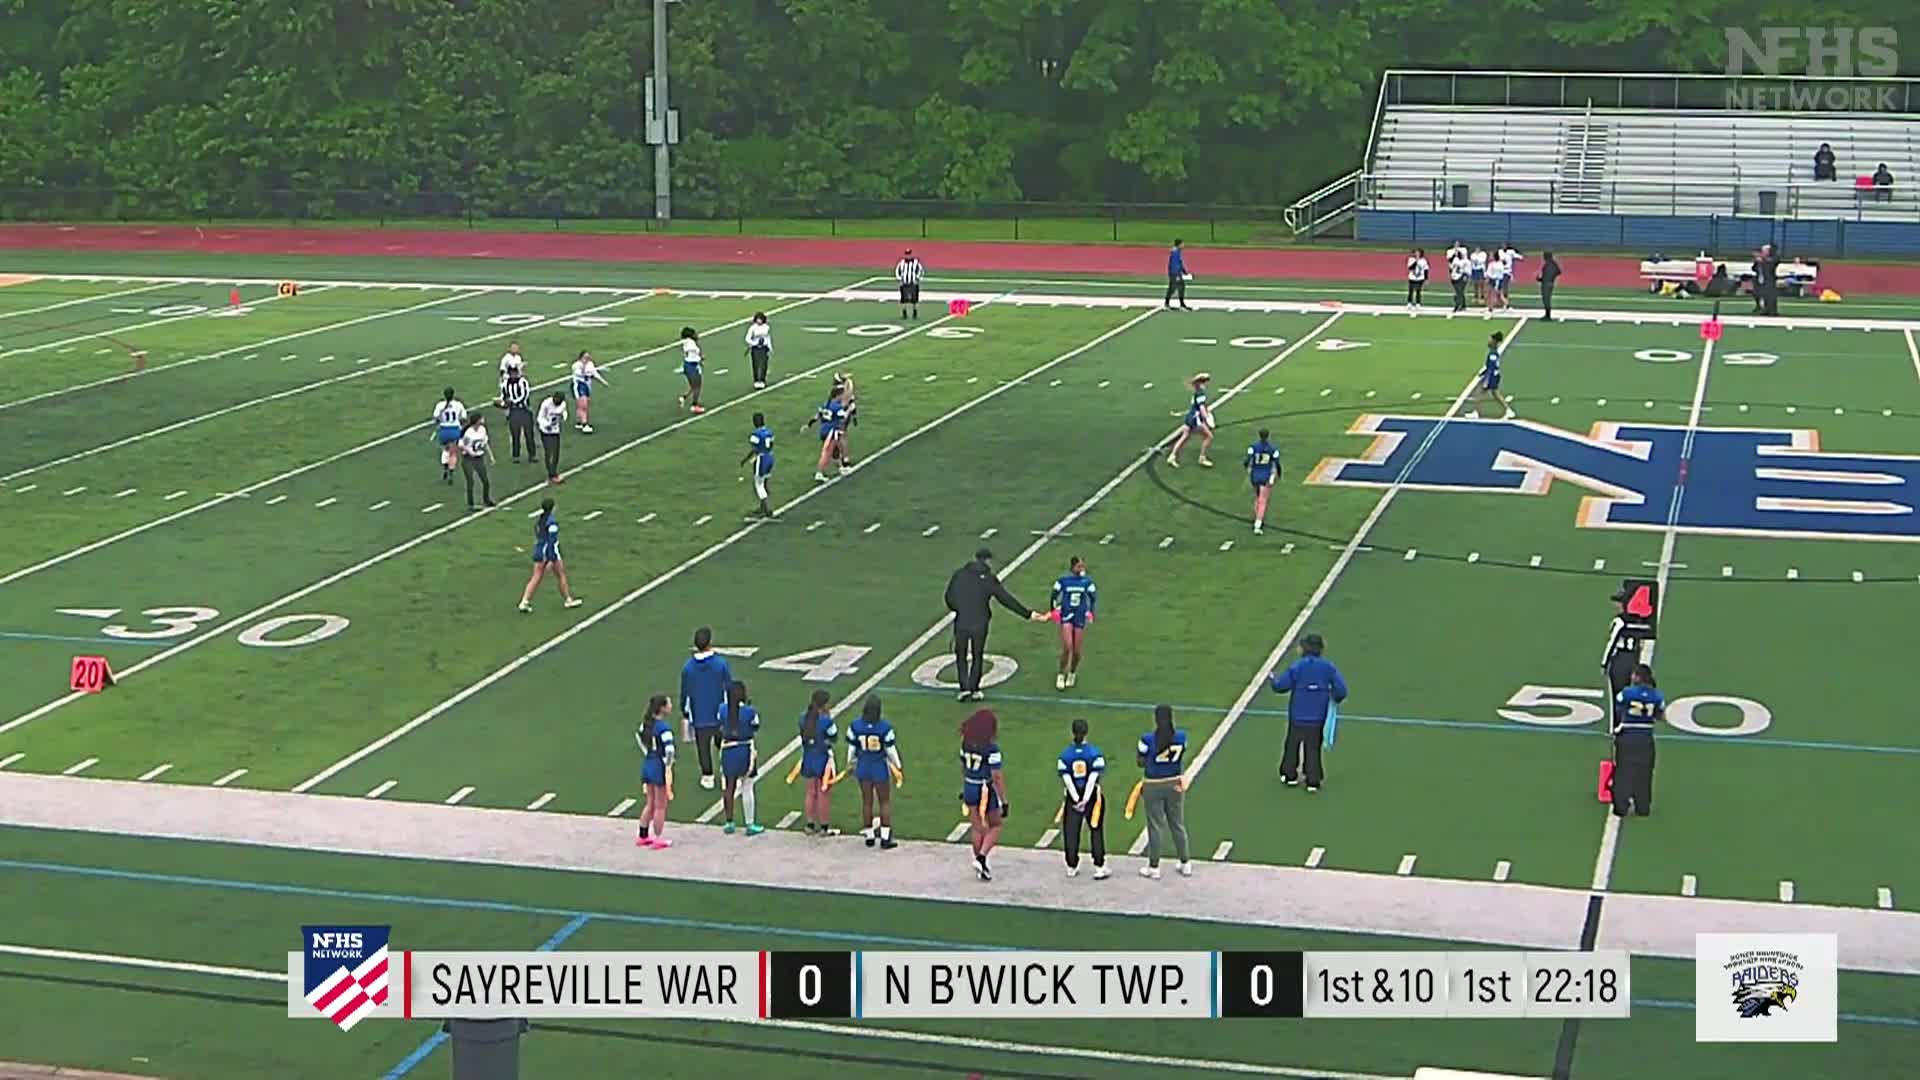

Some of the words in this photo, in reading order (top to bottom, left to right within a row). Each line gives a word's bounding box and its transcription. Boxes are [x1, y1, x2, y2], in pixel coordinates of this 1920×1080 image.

[444, 410, 457, 422] 11
[1070, 593, 1081, 606] 5
[1626, 585, 1653, 618] 4
[101, 606, 350, 647] 30
[74, 660, 99, 689] 20
[758, 644, 1019, 690] 40
[1496, 684, 1772, 736] 50
[965, 752, 984, 771] 17
[1155, 744, 1184, 763] 27
